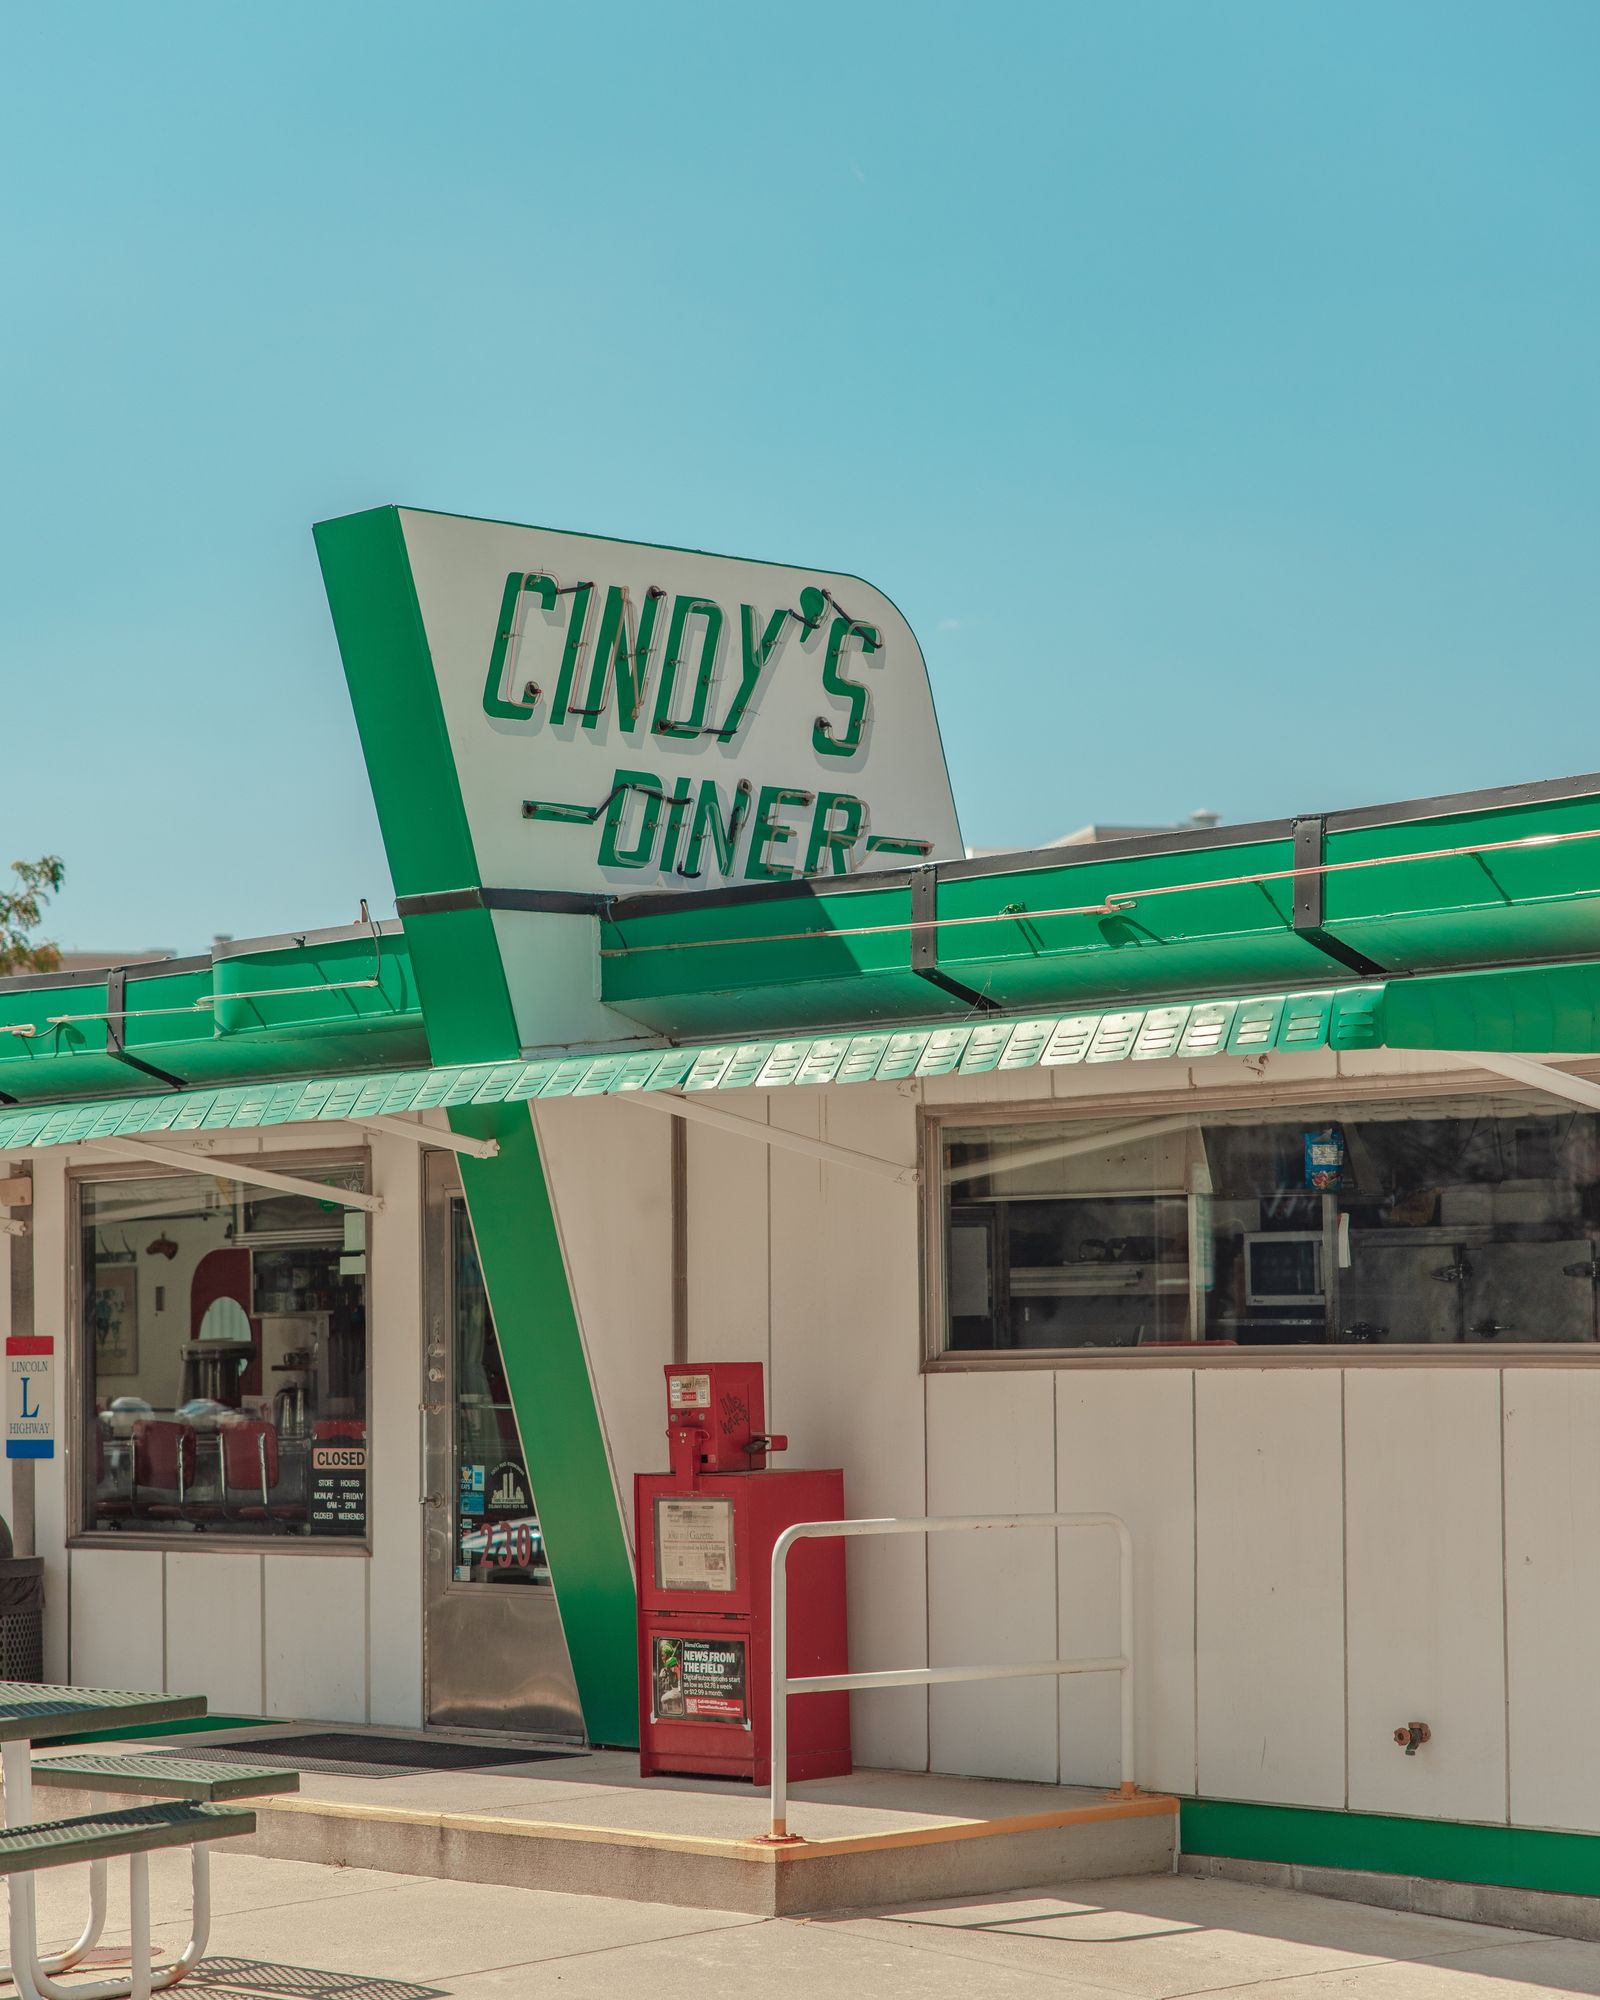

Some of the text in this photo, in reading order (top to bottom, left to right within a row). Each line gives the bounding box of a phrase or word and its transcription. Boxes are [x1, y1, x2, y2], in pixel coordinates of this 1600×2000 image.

[483, 571, 879, 757] CINDY'S
[597, 769, 866, 880] DINER
[11, 1361, 48, 1372] LINCOLN
[20, 1377, 40, 1418] L
[9, 1422, 50, 1434] HIGHWAY
[317, 1452, 365, 1466] CLOSED
[341, 1479, 360, 1488] HOURS
[343, 1493, 364, 1501] FRIDAY
[345, 1501, 357, 1510] 2PM
[313, 1512, 365, 1521] CLOSED WEEKENDS
[480, 1522, 532, 1569] 230
[684, 1650, 736, 1663] NEWS FROM
[684, 1662, 725, 1674] THE FIELD
